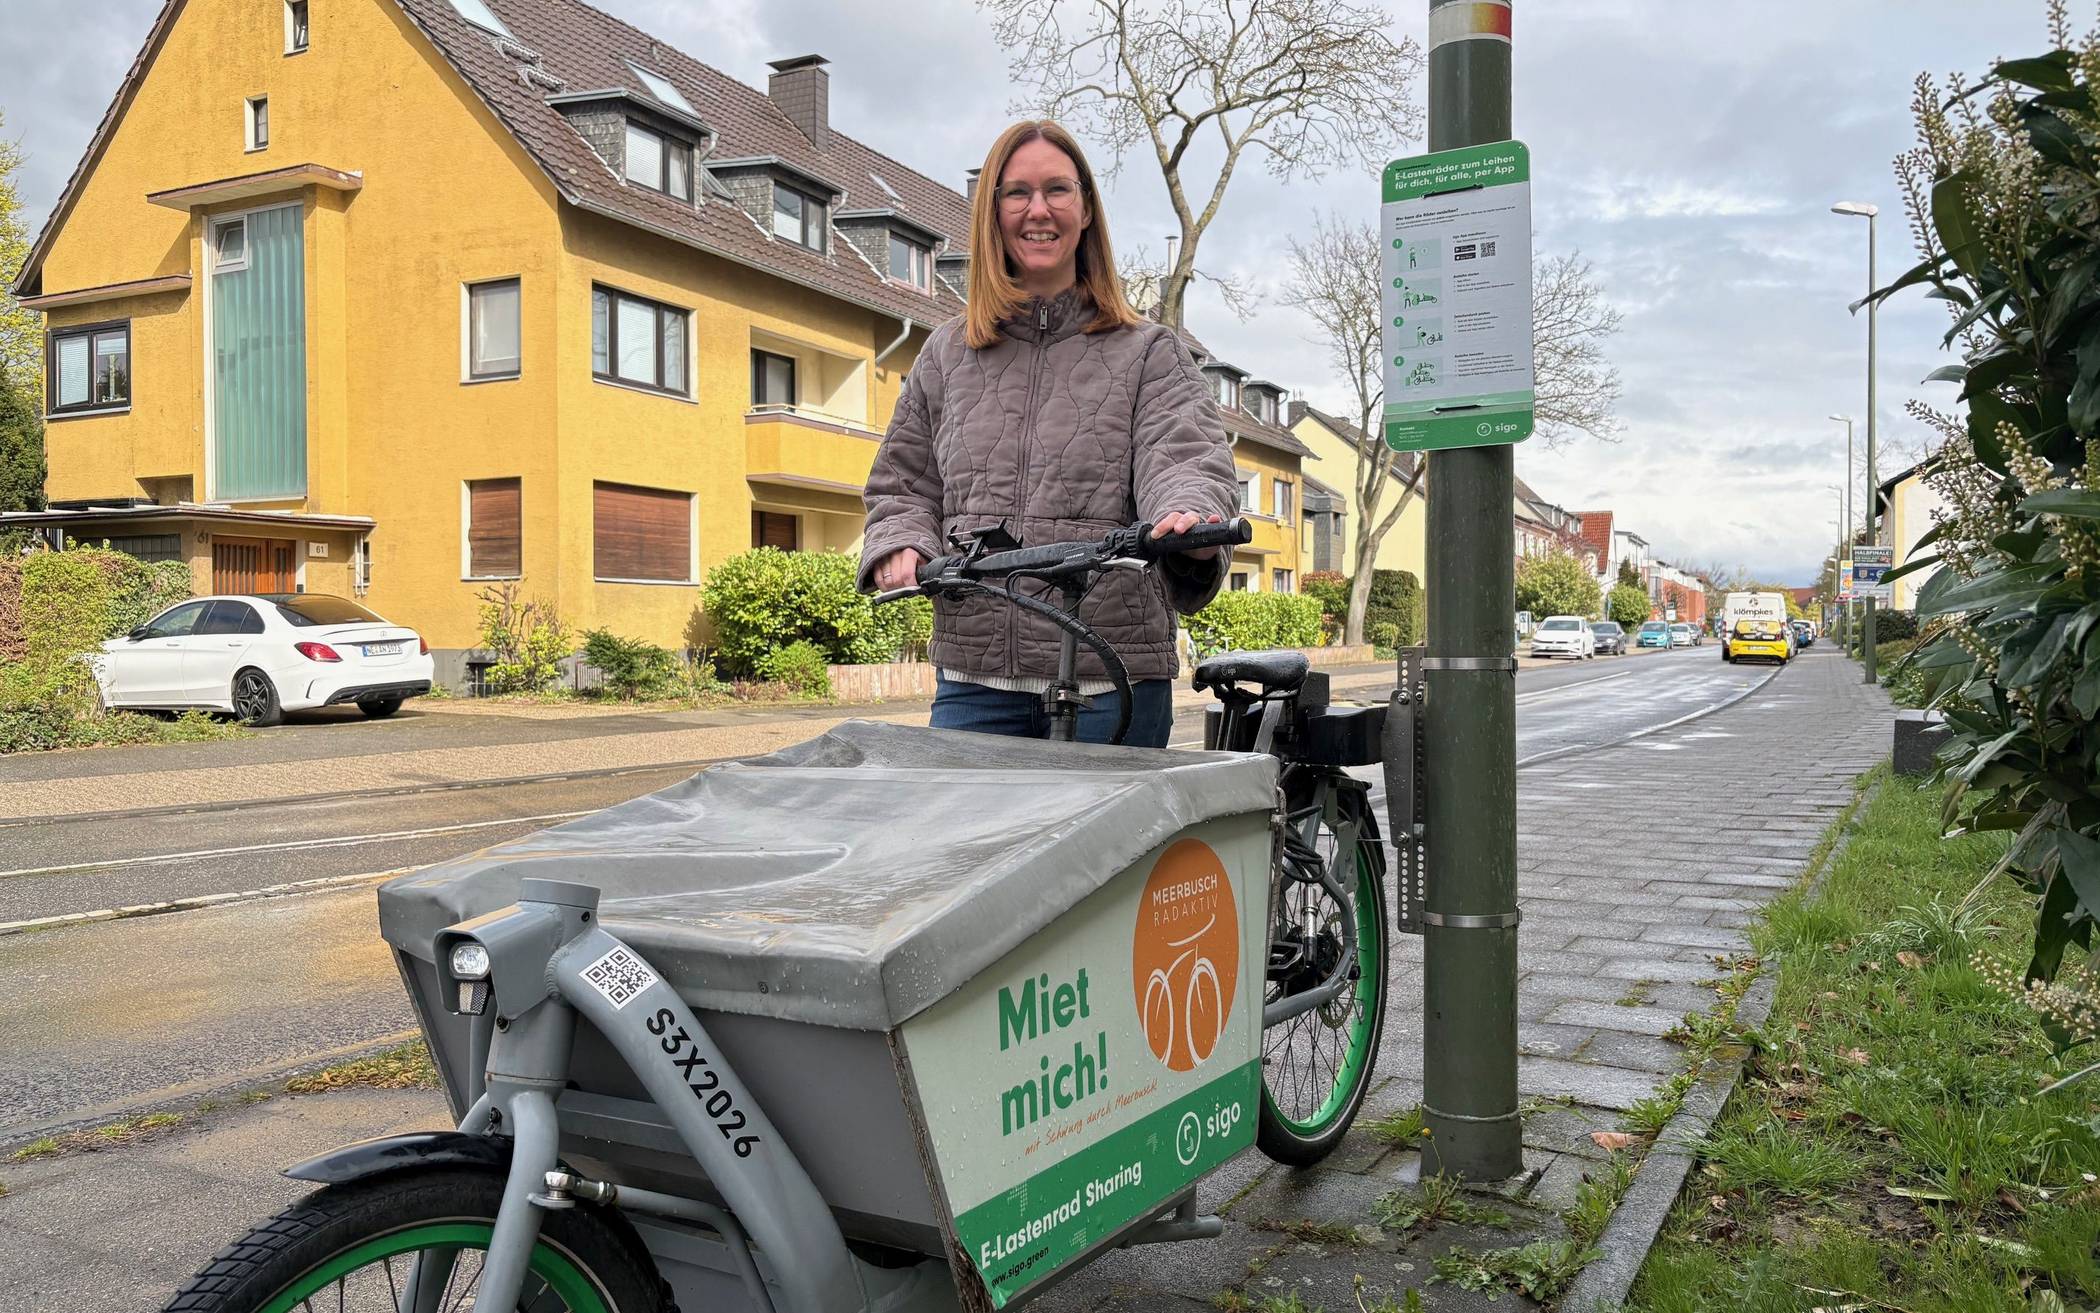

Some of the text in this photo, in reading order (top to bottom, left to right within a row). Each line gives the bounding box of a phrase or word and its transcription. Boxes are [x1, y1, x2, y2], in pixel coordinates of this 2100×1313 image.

[1395, 155, 1515, 181] E-Lastenräder zum Leihen
[1395, 181, 1407, 190] für
[1410, 177, 1432, 188] dich,
[1435, 175, 1447, 184] für
[1475, 170, 1491, 179] per
[1494, 165, 1515, 175] App
[1494, 422, 1518, 433] sigo
[315, 545, 324, 553] 61
[1733, 607, 1774, 617] klömpkes
[1152, 873, 1218, 907] MEERBUSCH
[1153, 893, 1219, 927] RADAKTIV
[998, 967, 1091, 1052] Miet
[646, 1007, 761, 1158] S3X2026
[1002, 1031, 1109, 1137] mich!
[1045, 1119, 1083, 1146] Schwung
[1087, 1102, 1111, 1125] durch
[1115, 1078, 1158, 1110] Meerbusch!
[1206, 1101, 1241, 1138] sigo
[980, 1160, 1142, 1270] E-Lastenrad Sharing
